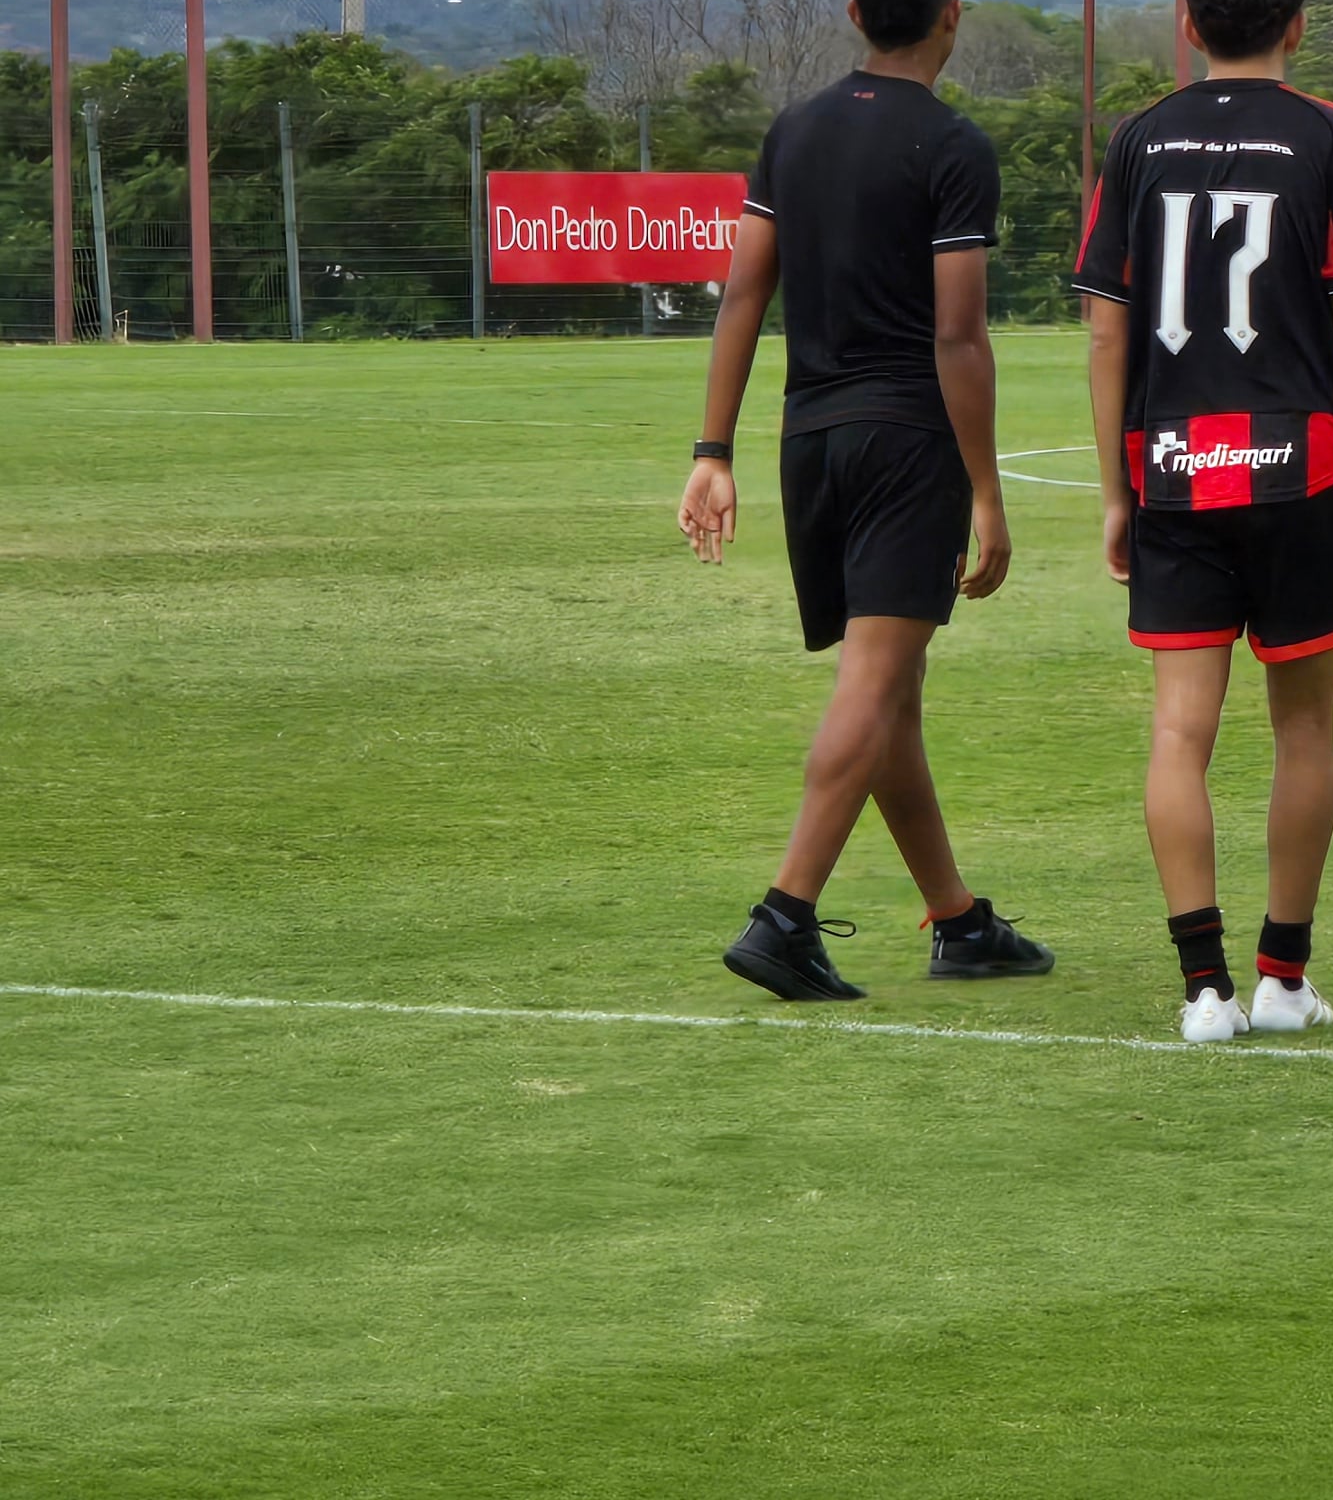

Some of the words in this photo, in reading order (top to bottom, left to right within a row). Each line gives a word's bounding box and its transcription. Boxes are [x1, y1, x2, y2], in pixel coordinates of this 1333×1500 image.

[495, 205, 548, 251] Don
[551, 205, 617, 251] Pedro
[627, 206, 677, 251] Don
[1155, 190, 1280, 356] 17
[1172, 441, 1294, 477] medismart
